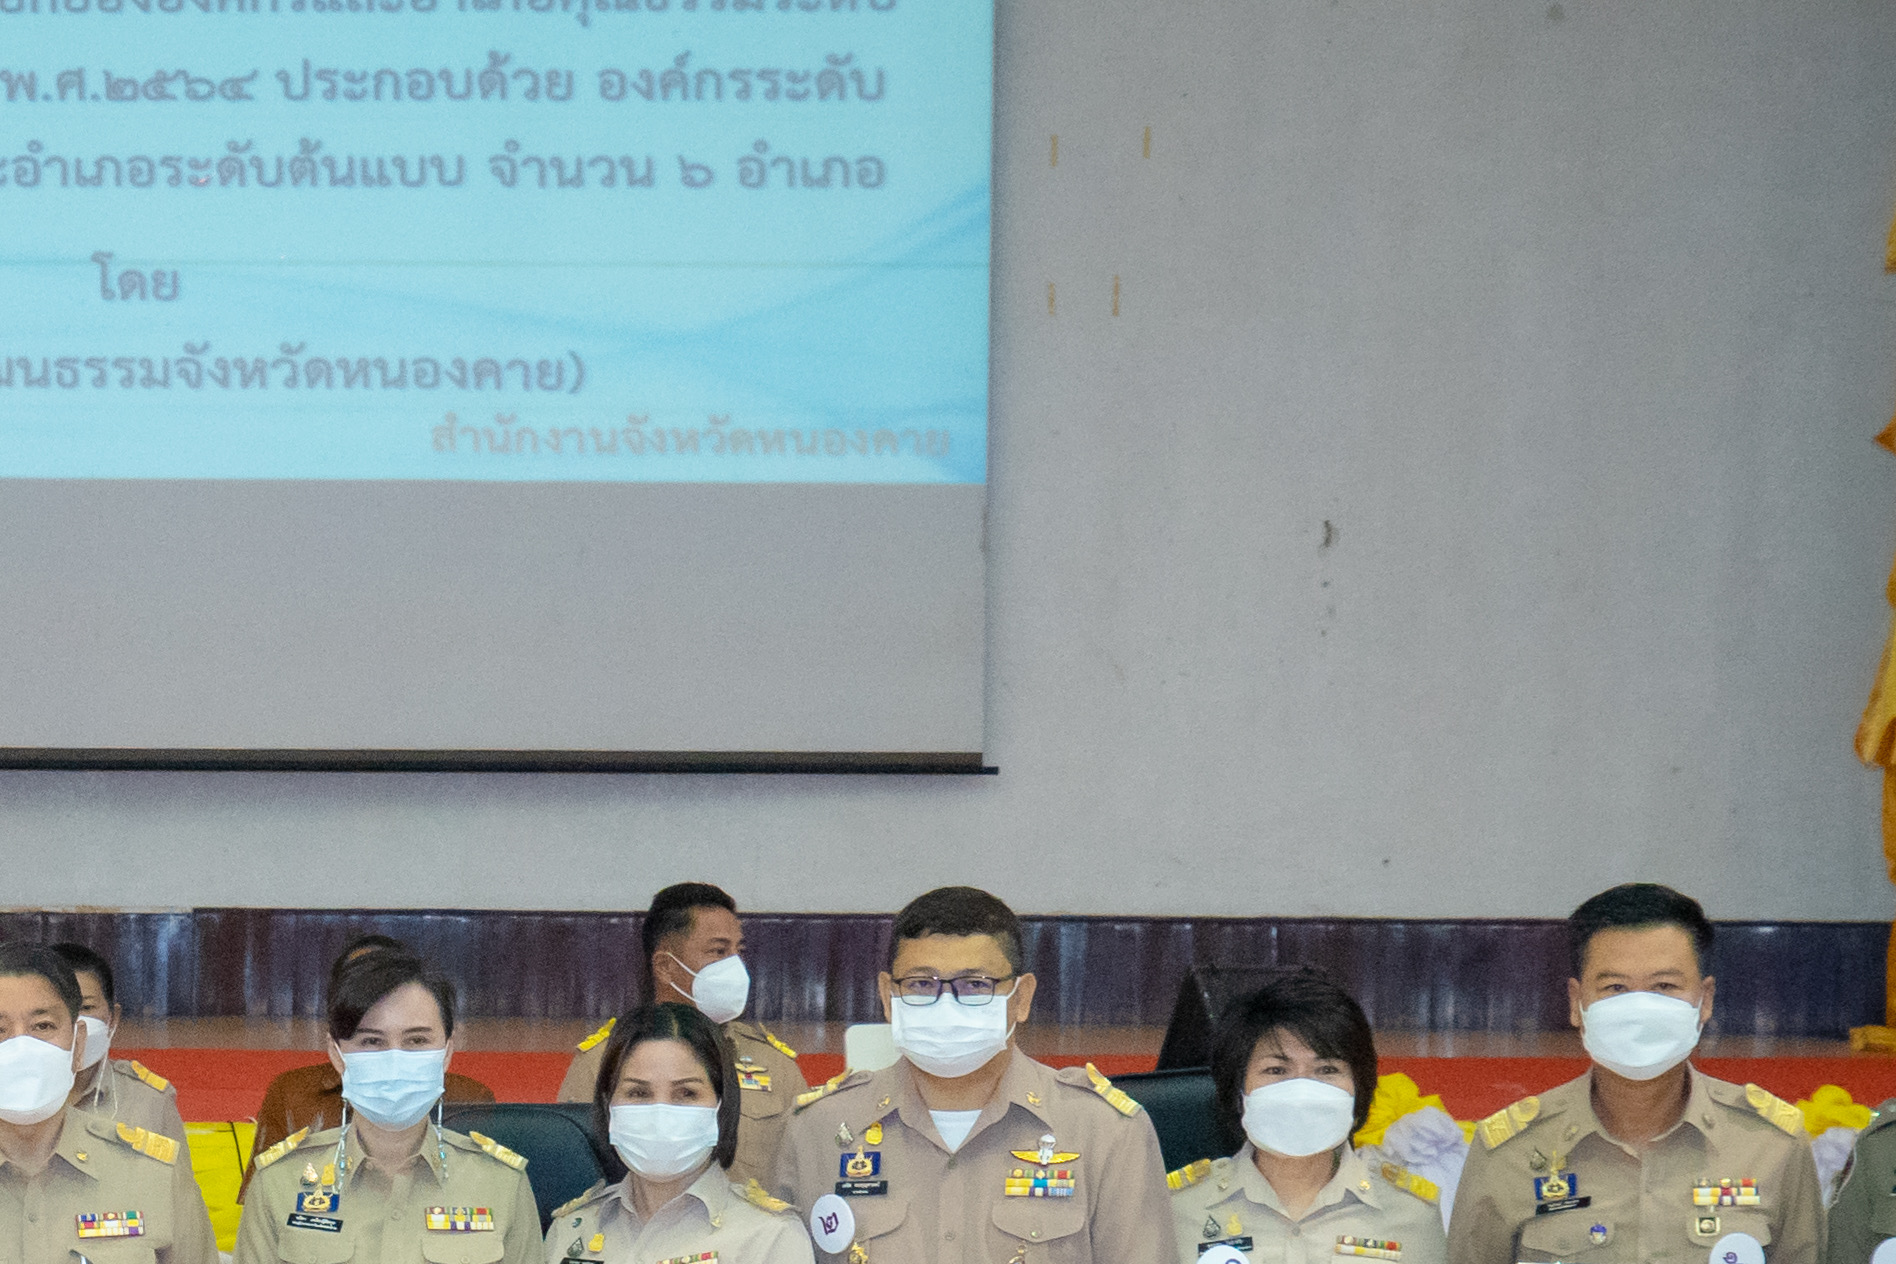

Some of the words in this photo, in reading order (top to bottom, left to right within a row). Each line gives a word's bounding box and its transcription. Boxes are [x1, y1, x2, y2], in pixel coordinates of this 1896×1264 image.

[276, 51, 574, 103] ประกอบด้วย
[598, 51, 886, 103] องค์กรระดับ
[488, 139, 655, 188] จำนวน
[678, 155, 715, 189] ๖
[737, 139, 886, 189] อำเภอ
[90, 251, 180, 302] โดย
[431, 411, 950, 456] สำนักงานจังหวัดหนองคาย
[818, 1211, 840, 1236] ๒
